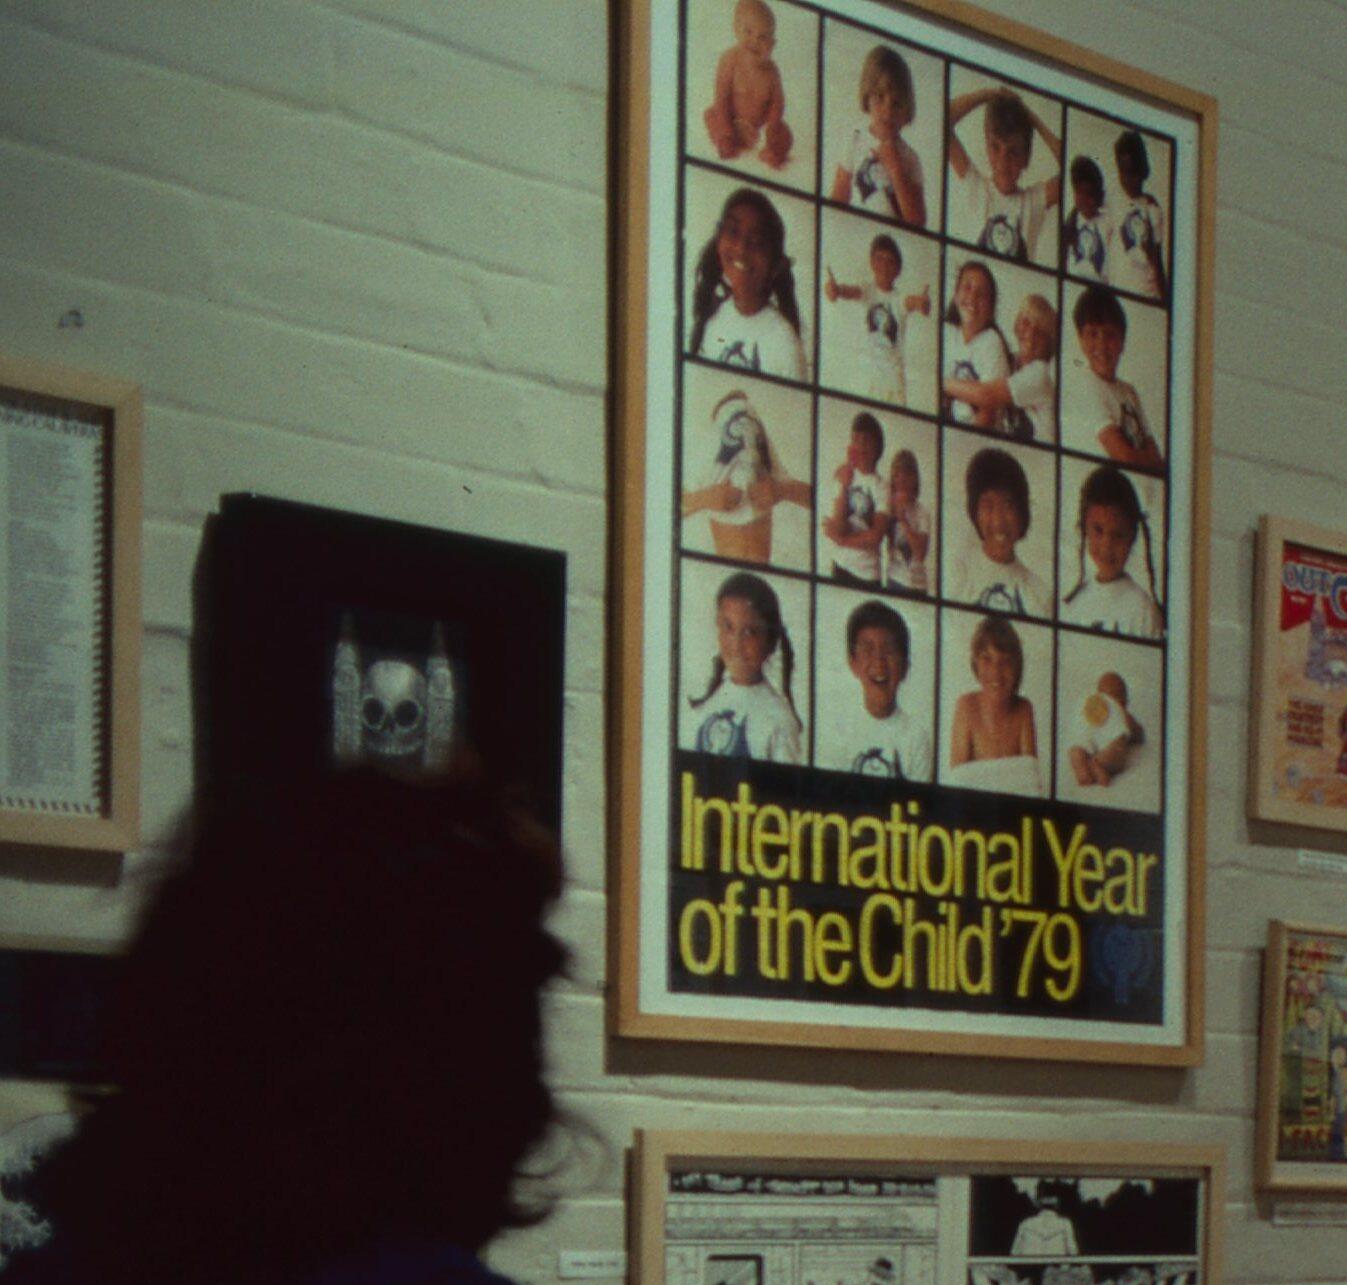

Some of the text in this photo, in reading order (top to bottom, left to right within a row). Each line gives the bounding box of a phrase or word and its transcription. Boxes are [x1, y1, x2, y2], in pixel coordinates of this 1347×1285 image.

[680, 771, 1158, 917] International Year
[679, 880, 745, 976] of
[751, 885, 853, 986] the
[858, 892, 993, 996] Child
